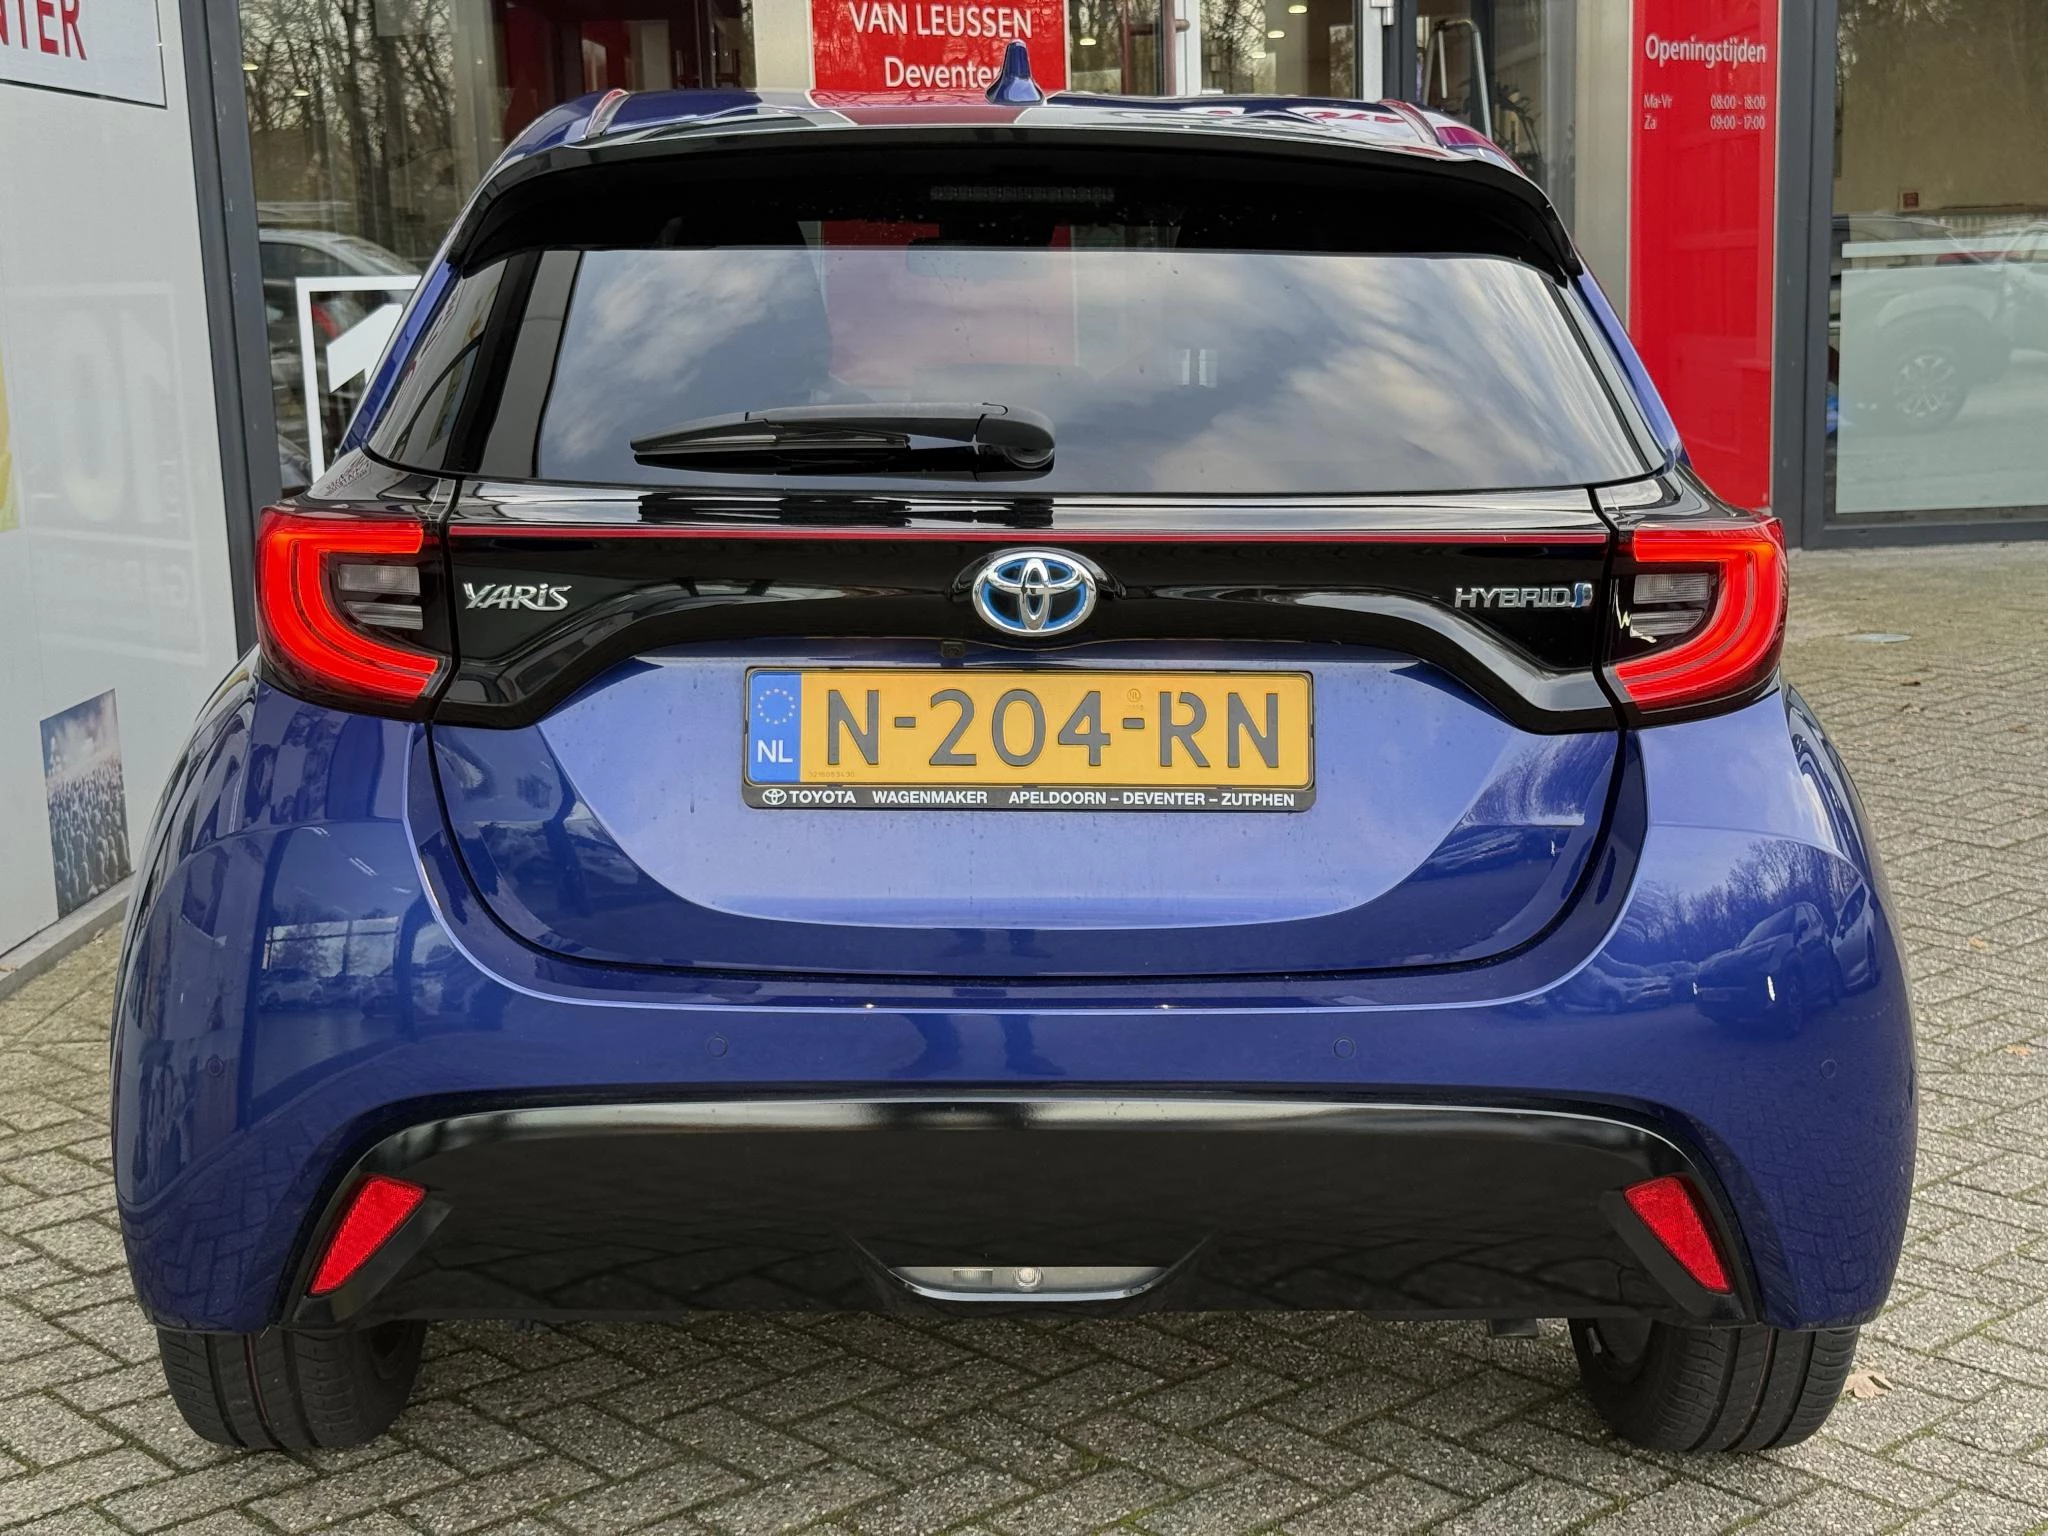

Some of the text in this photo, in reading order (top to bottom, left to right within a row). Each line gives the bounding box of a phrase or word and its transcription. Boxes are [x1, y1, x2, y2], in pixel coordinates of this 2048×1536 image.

[849, 2, 1032, 38] VAN LEUSSEN
[1645, 34, 1767, 69] Openingstijden
[1643, 93, 1673, 109] Ma-Vr
[1710, 94, 1736, 110] 08:00
[1744, 94, 1767, 110] 18:00
[1643, 113, 1656, 130] Za
[1710, 114, 1736, 130] 09:00
[1744, 114, 1766, 130] 17:00
[1454, 587, 1572, 608] HYBRID
[827, 688, 1281, 769] N-204-RN
[757, 739, 793, 763] NL
[789, 790, 857, 804] TOYOTA
[872, 790, 988, 804] WAGENMAKER
[1008, 791, 1107, 806] APELDOORN
[1122, 792, 1206, 806] DEVENTER
[1221, 793, 1295, 808] ZUTPHEN
